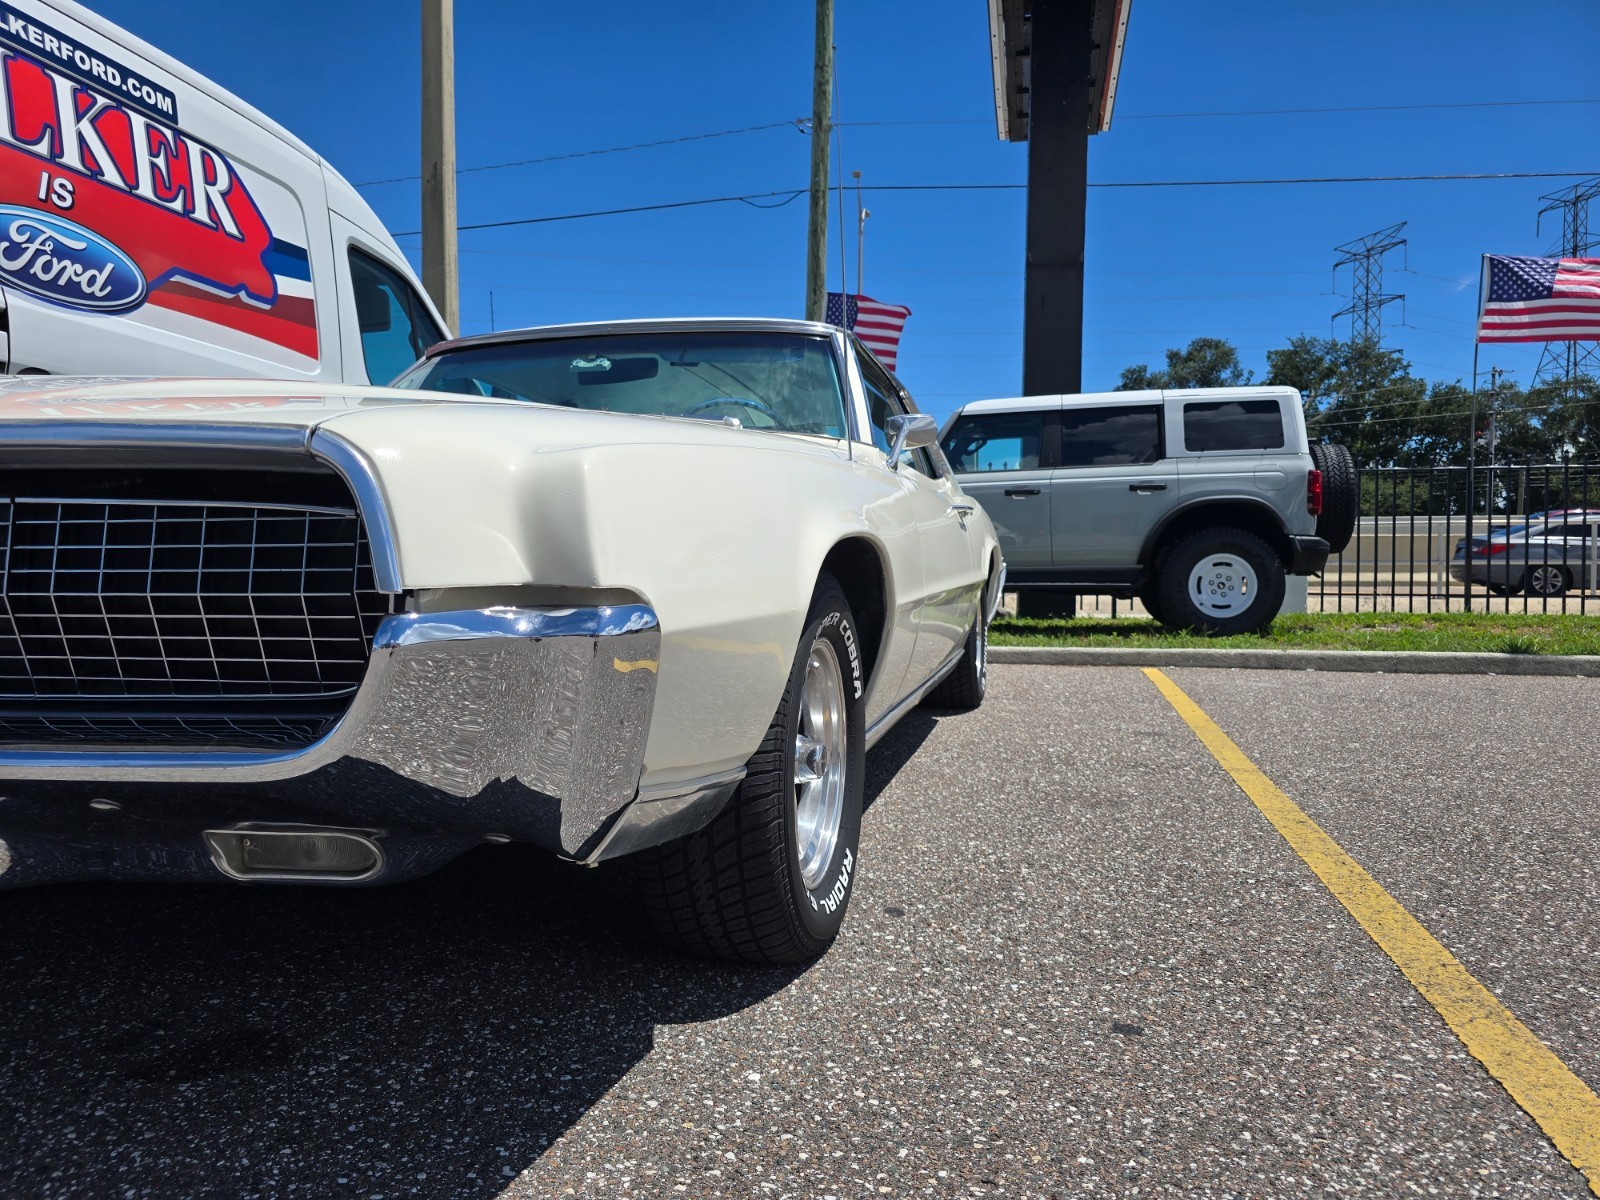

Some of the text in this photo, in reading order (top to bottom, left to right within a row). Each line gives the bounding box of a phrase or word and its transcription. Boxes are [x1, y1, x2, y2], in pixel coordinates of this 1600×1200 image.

[0, 47, 243, 241] LKER
[38, 171, 74, 208] IS
[0, 219, 115, 297] Ford
[839, 619, 862, 700] COBRA
[819, 847, 853, 914] RADIAL
